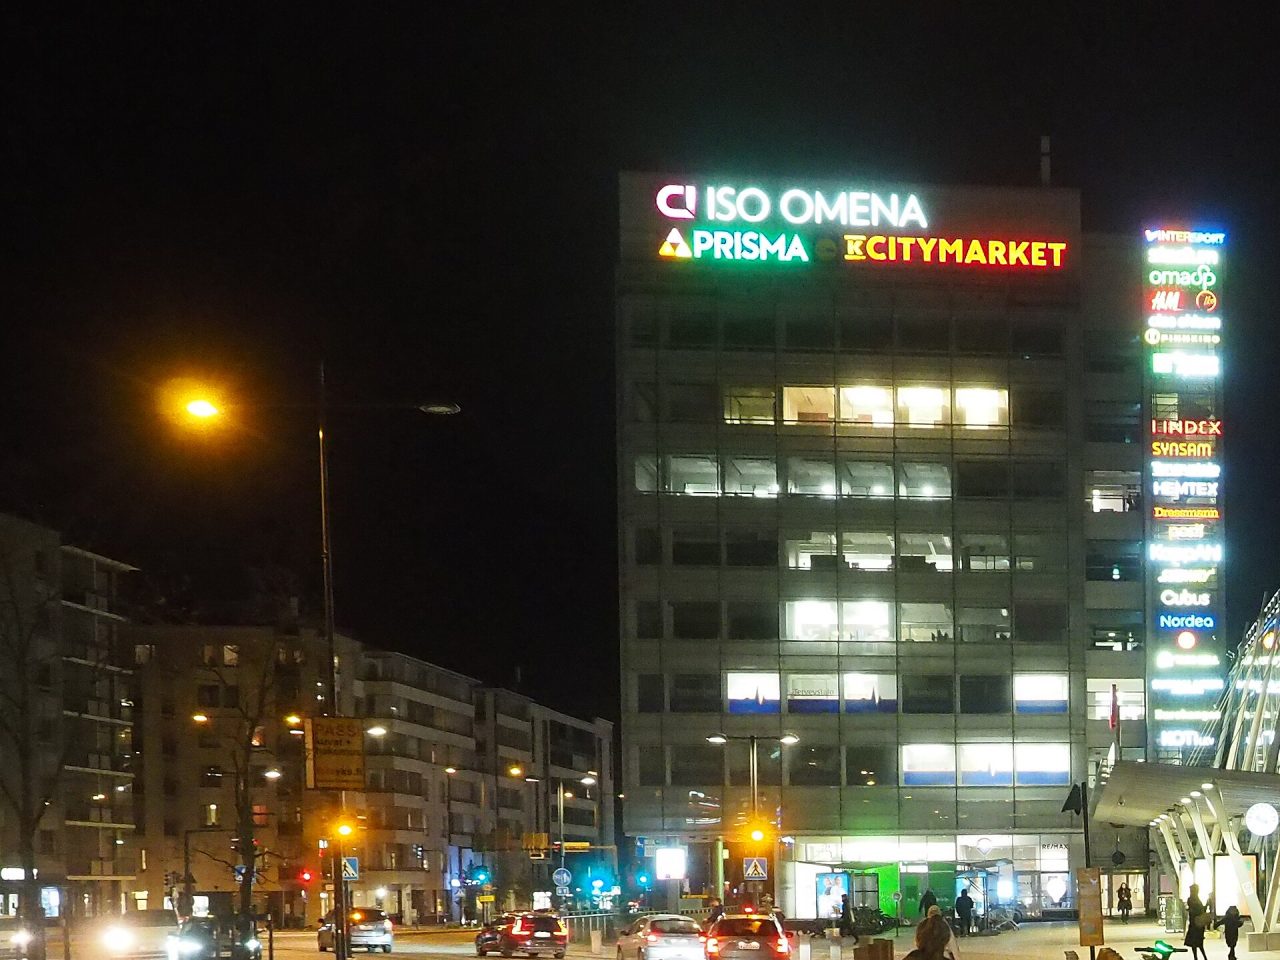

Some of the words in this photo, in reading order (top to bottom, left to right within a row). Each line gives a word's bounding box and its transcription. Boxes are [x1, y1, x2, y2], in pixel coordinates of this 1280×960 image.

[706, 186, 771, 224] ISO
[780, 189, 928, 229] OMENA
[693, 230, 809, 263] PRISMA
[1152, 441, 1212, 457] SYNSAM
[1160, 589, 1210, 606] Cubus
[1160, 615, 1214, 628] Nordea
